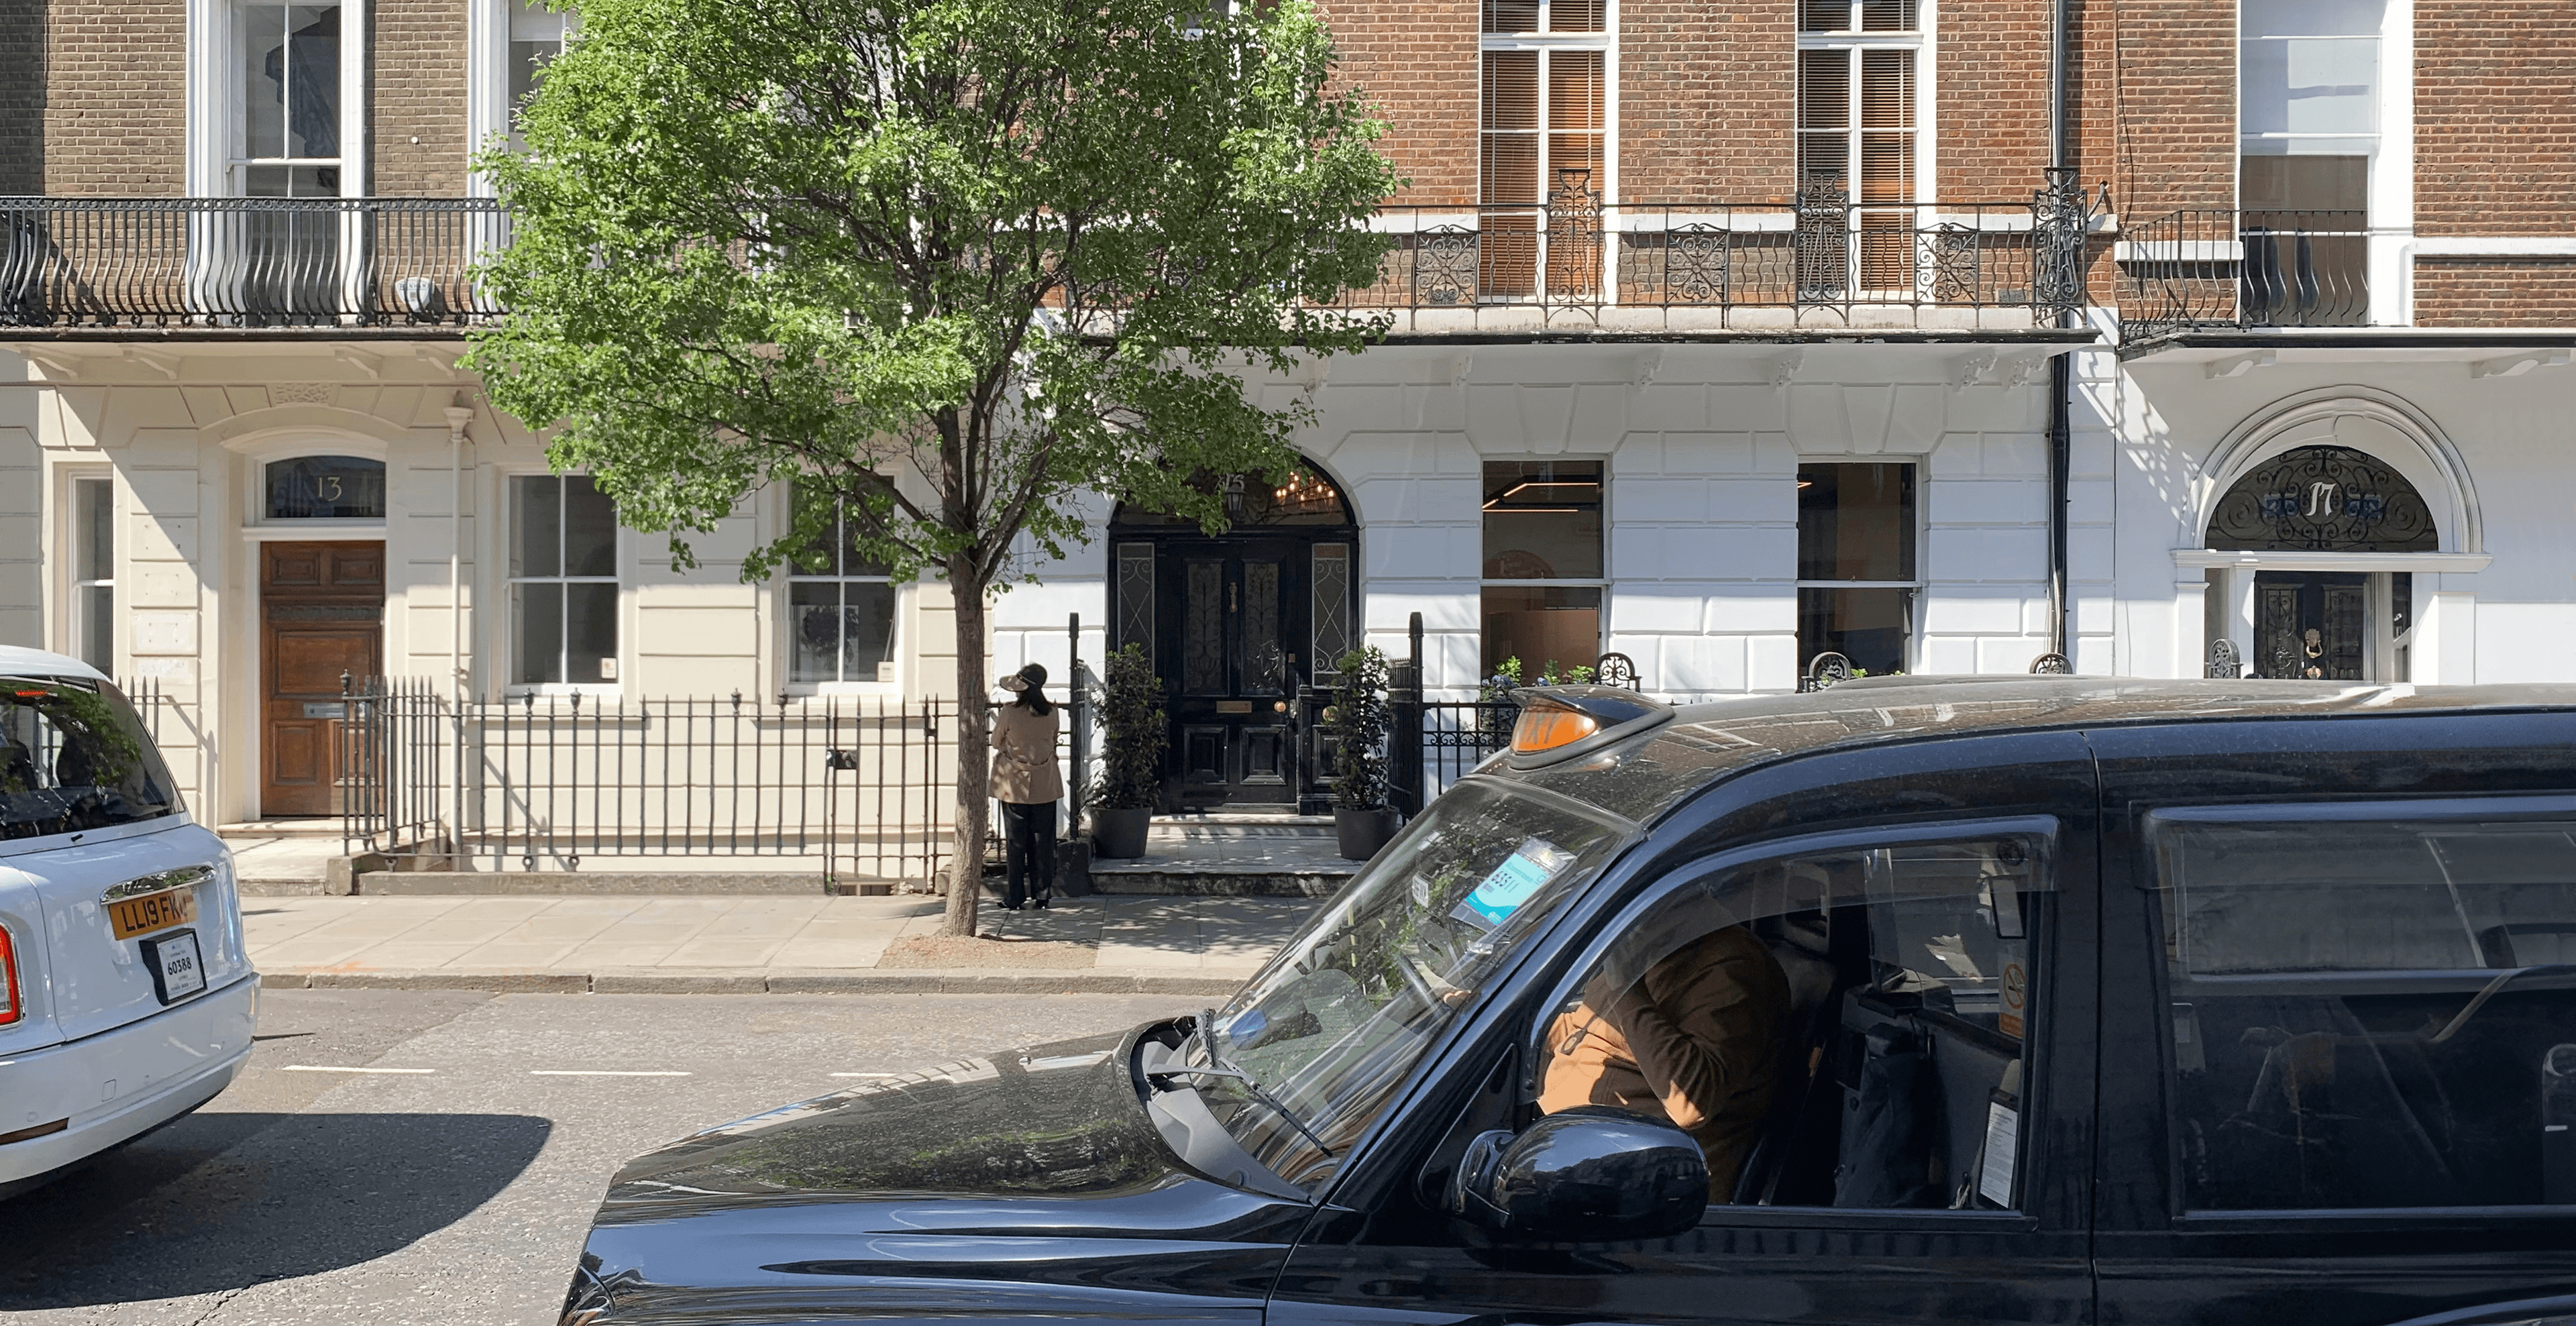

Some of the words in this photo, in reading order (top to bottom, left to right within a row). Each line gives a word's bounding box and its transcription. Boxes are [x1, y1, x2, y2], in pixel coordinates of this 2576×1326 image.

[319, 476, 342, 502] 13
[2306, 482, 2337, 516] 17
[121, 899, 160, 932] LL19
[168, 957, 192, 975] 60388
